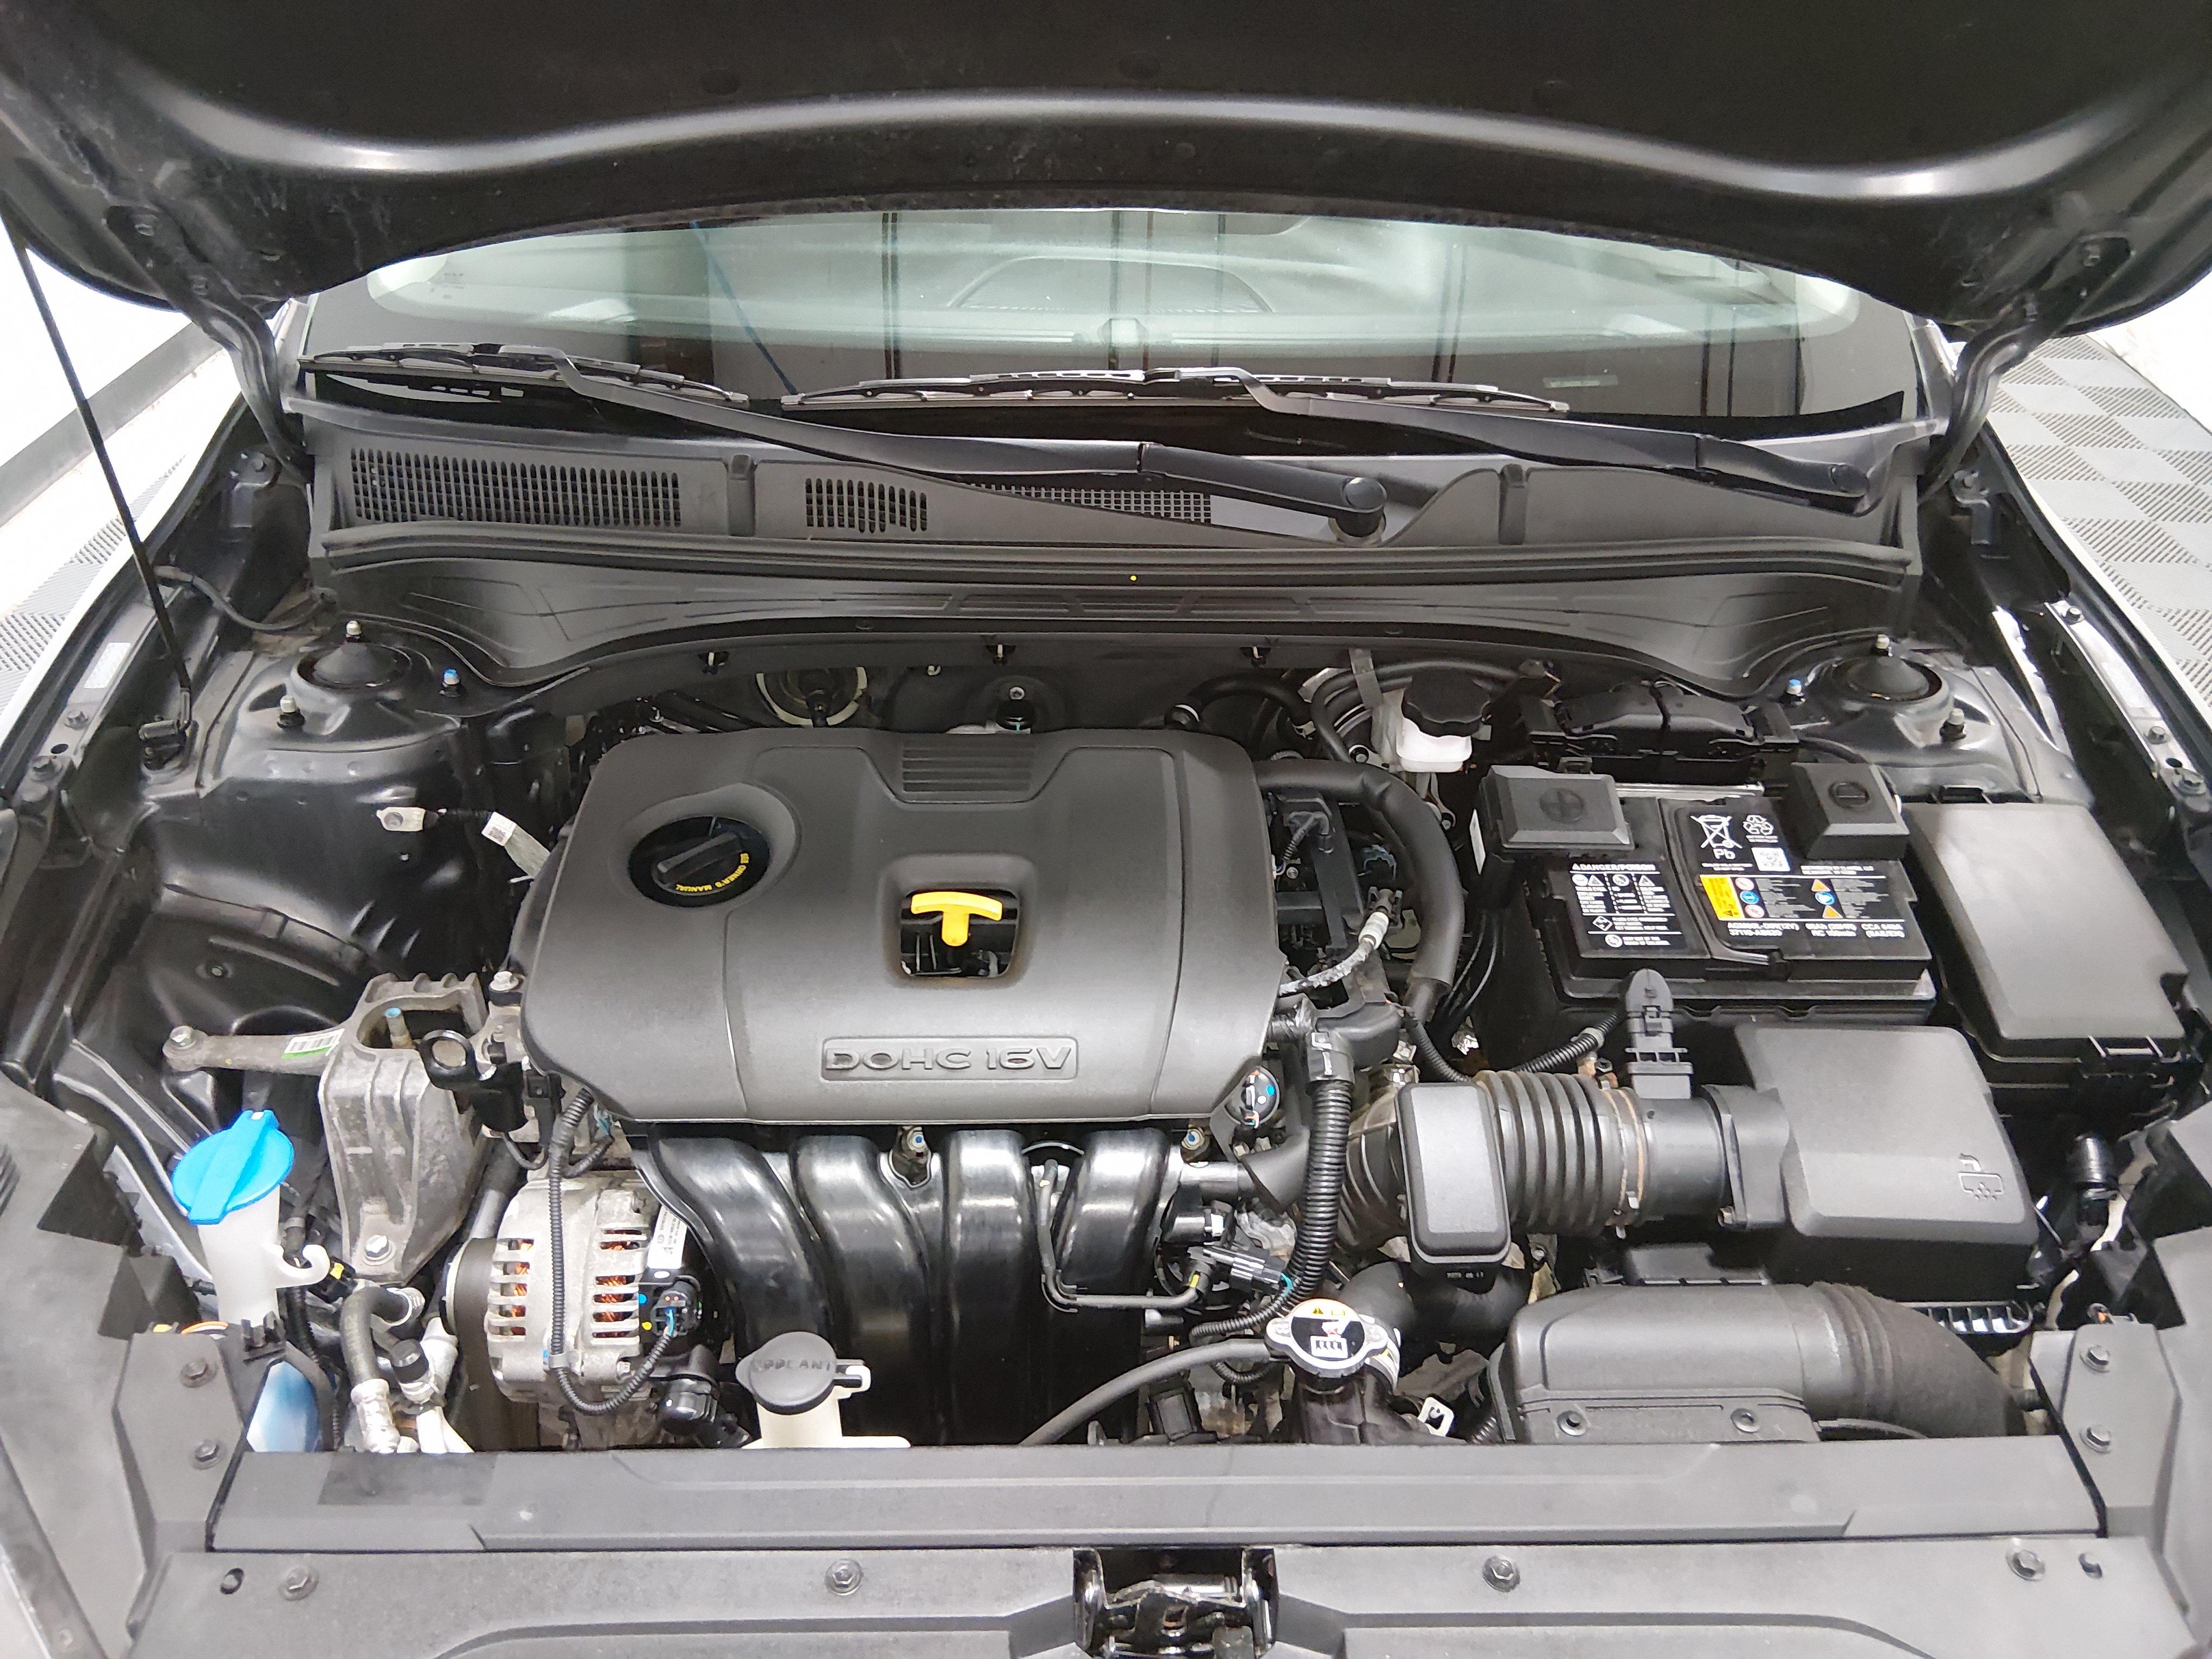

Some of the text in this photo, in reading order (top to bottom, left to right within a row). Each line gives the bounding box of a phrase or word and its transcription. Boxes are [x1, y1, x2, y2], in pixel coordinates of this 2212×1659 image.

[1713, 848, 1735, 859] Pb
[676, 884, 712, 892] MANUAL
[825, 1047, 1072, 1070] DOHC 16V
[750, 1358, 832, 1372] COOLANT
